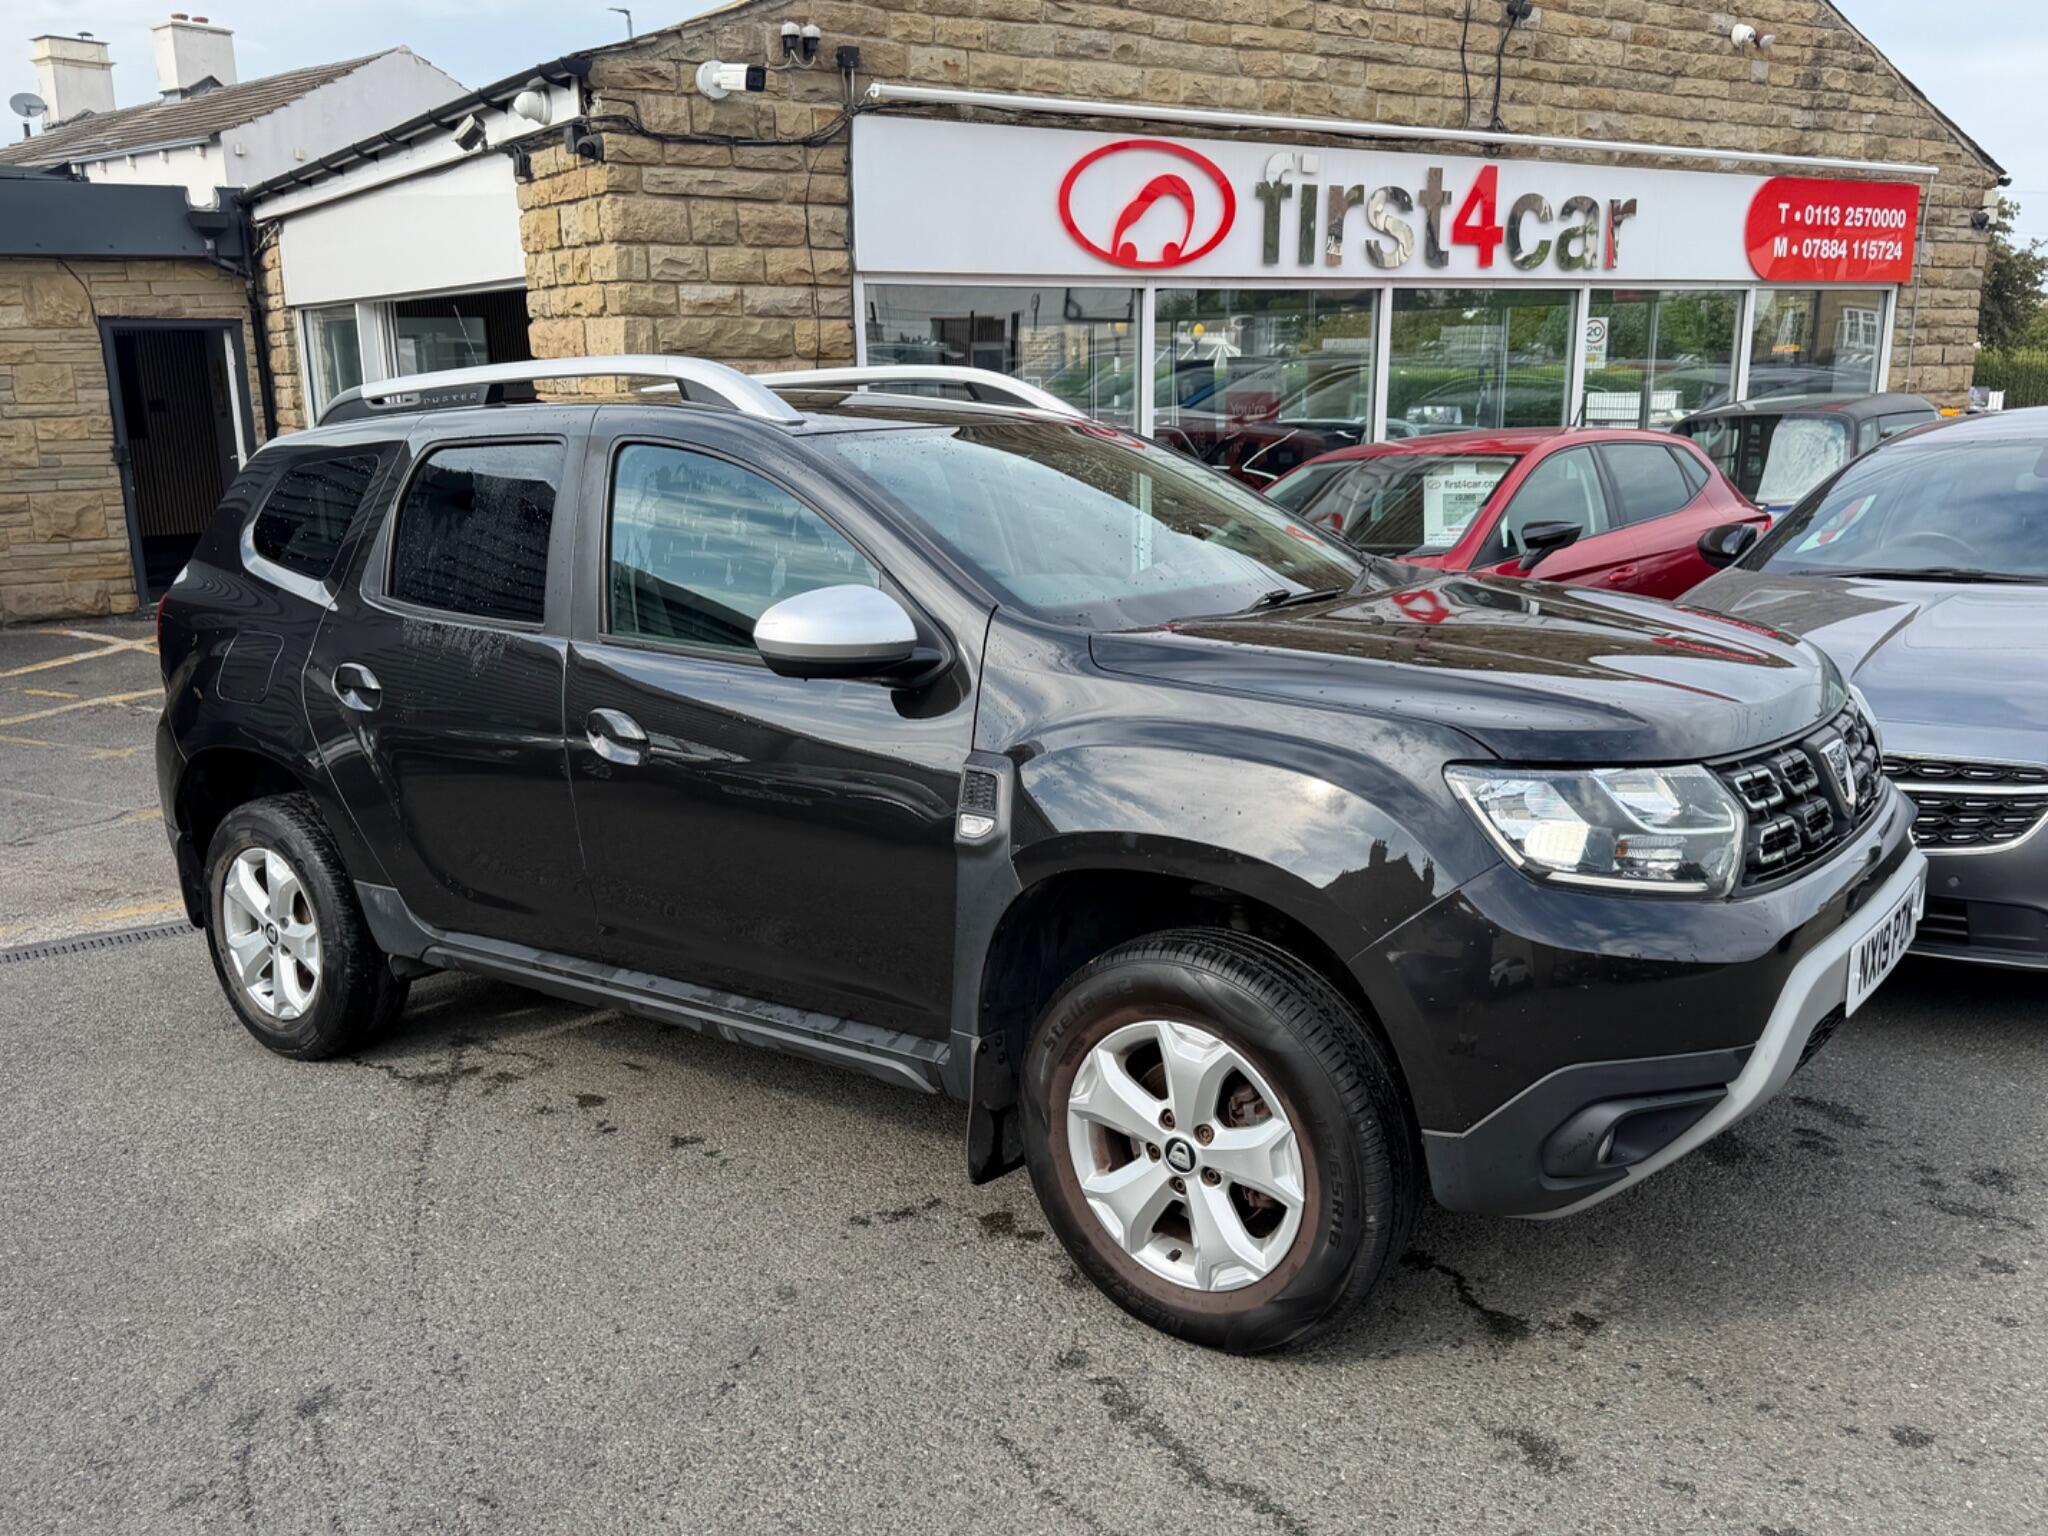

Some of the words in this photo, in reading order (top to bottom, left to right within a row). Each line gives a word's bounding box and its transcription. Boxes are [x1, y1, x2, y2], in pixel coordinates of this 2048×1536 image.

[1255, 151, 1638, 271] first4car
[1778, 202, 1790, 224] T
[1804, 204, 1840, 226] 0113
[1844, 206, 1907, 229] 2570000
[1773, 237, 1788, 258] M
[1802, 238, 1848, 259] 07884
[1852, 240, 1903, 261] 115724
[424, 392, 478, 405] DUSTER
[1858, 919, 1892, 995] NX19
